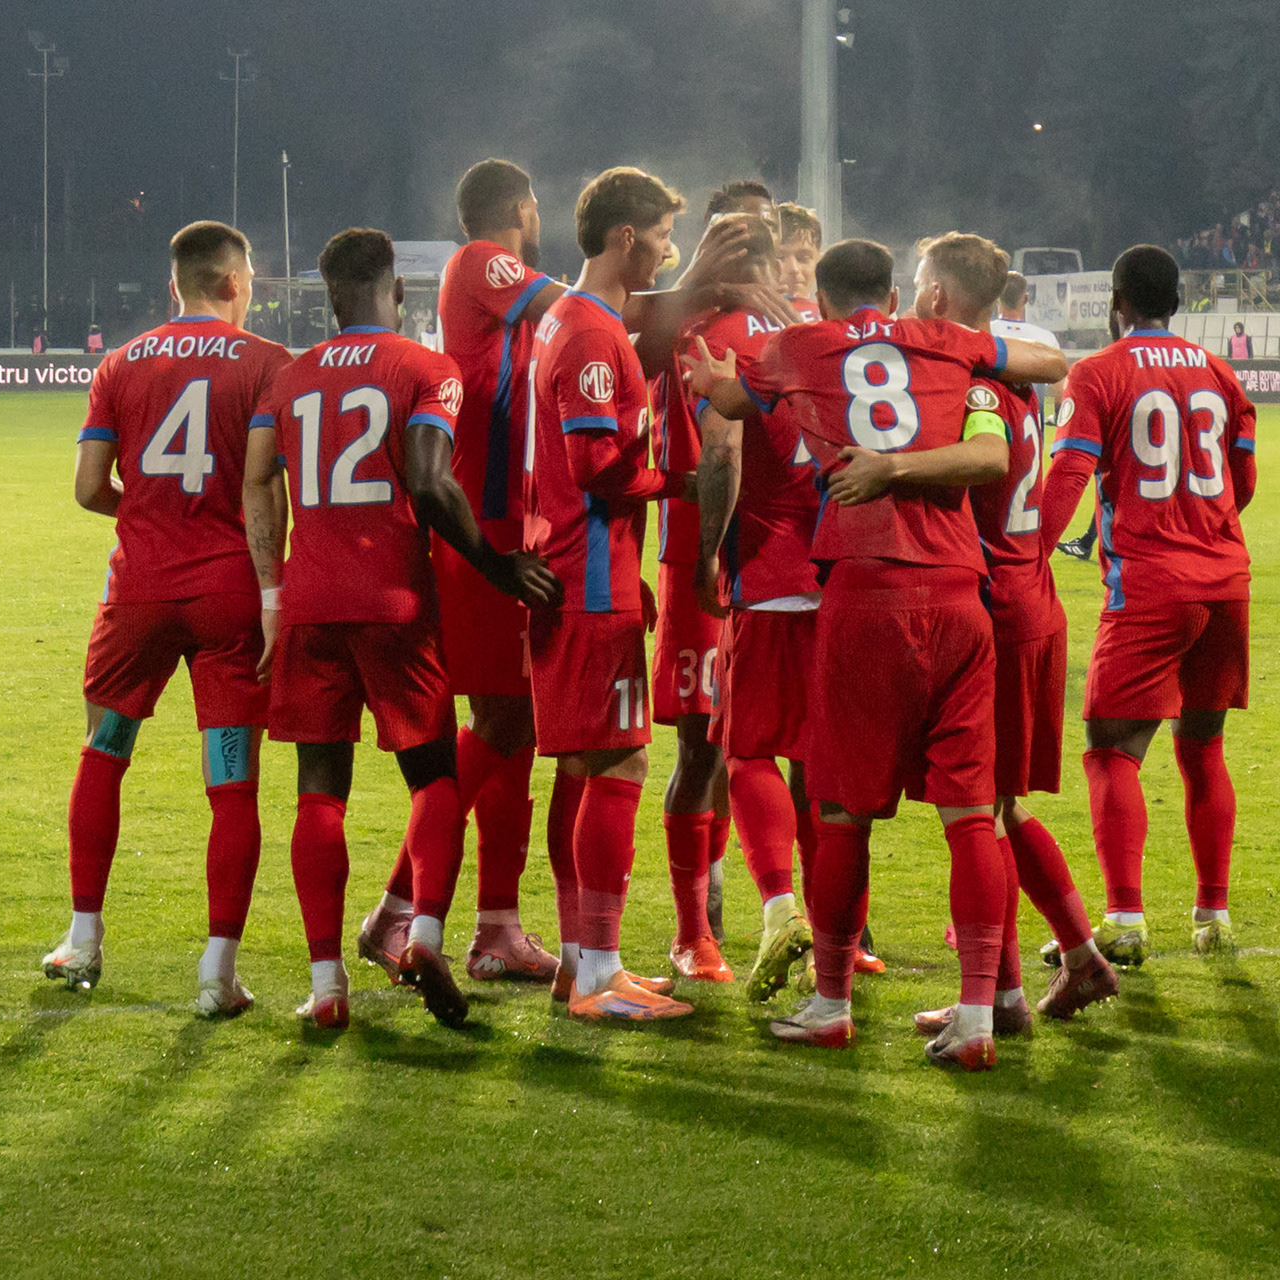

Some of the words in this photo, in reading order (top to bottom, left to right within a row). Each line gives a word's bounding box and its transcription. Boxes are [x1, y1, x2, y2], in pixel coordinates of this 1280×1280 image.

[34, 363, 98, 384] victo
[126, 334, 247, 363] GRAOVAC
[319, 344, 376, 368] KIKI
[1129, 345, 1207, 369] THIAM
[841, 340, 920, 453] 8
[140, 377, 215, 495] 4
[292, 384, 394, 508] 12
[1129, 388, 1229, 501] 93
[614, 677, 645, 730] 11
